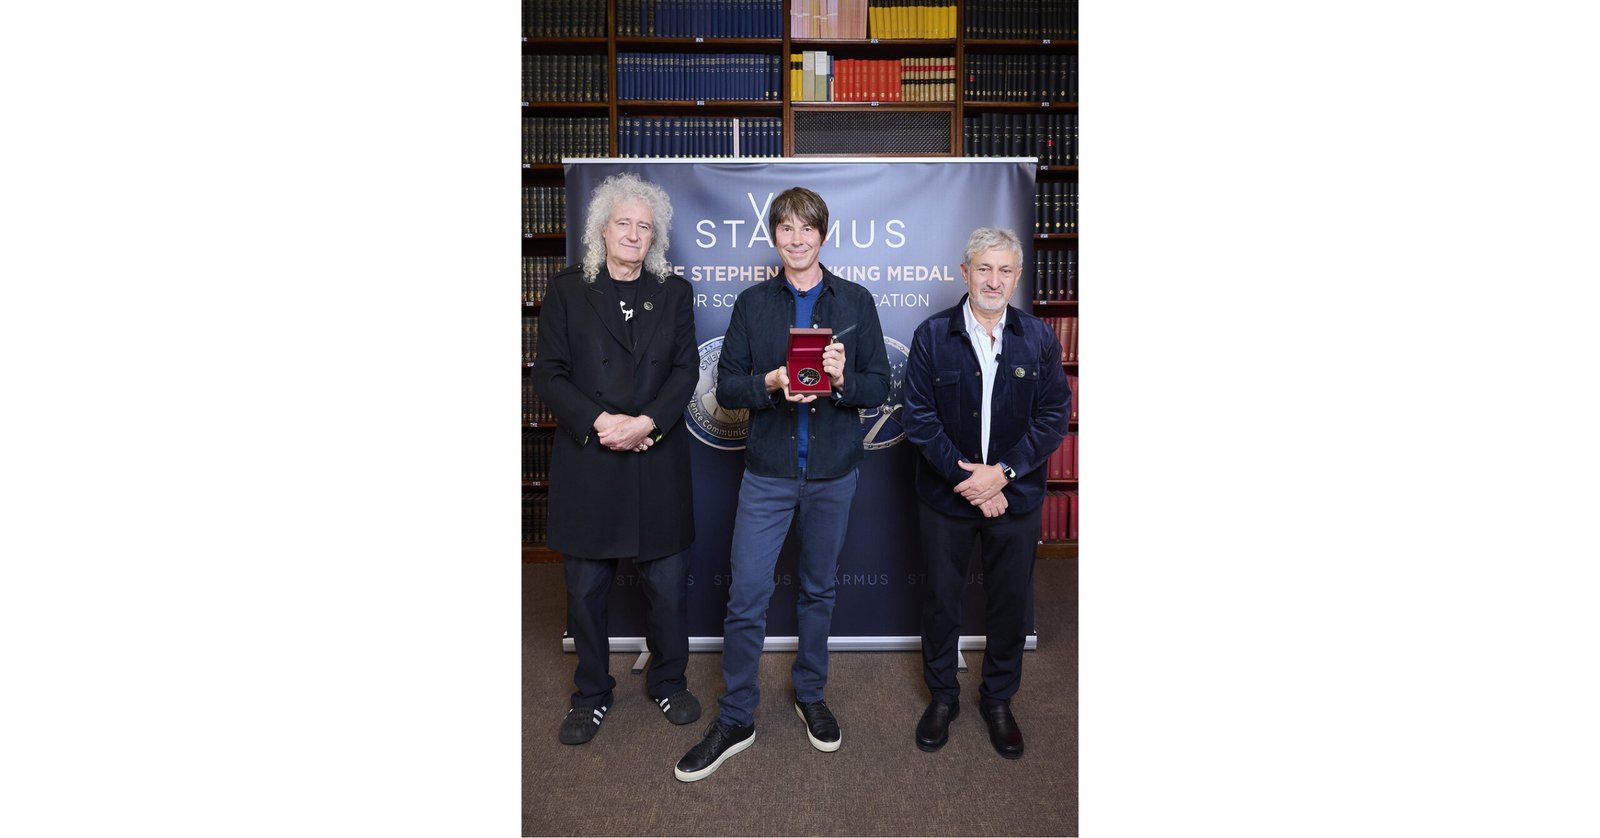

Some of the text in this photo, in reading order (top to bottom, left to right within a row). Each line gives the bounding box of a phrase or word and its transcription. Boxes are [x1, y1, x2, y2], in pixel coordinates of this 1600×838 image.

[826, 265, 881, 282] KING
[887, 265, 954, 282] MEDAL
[689, 399, 748, 437] ience Communic
